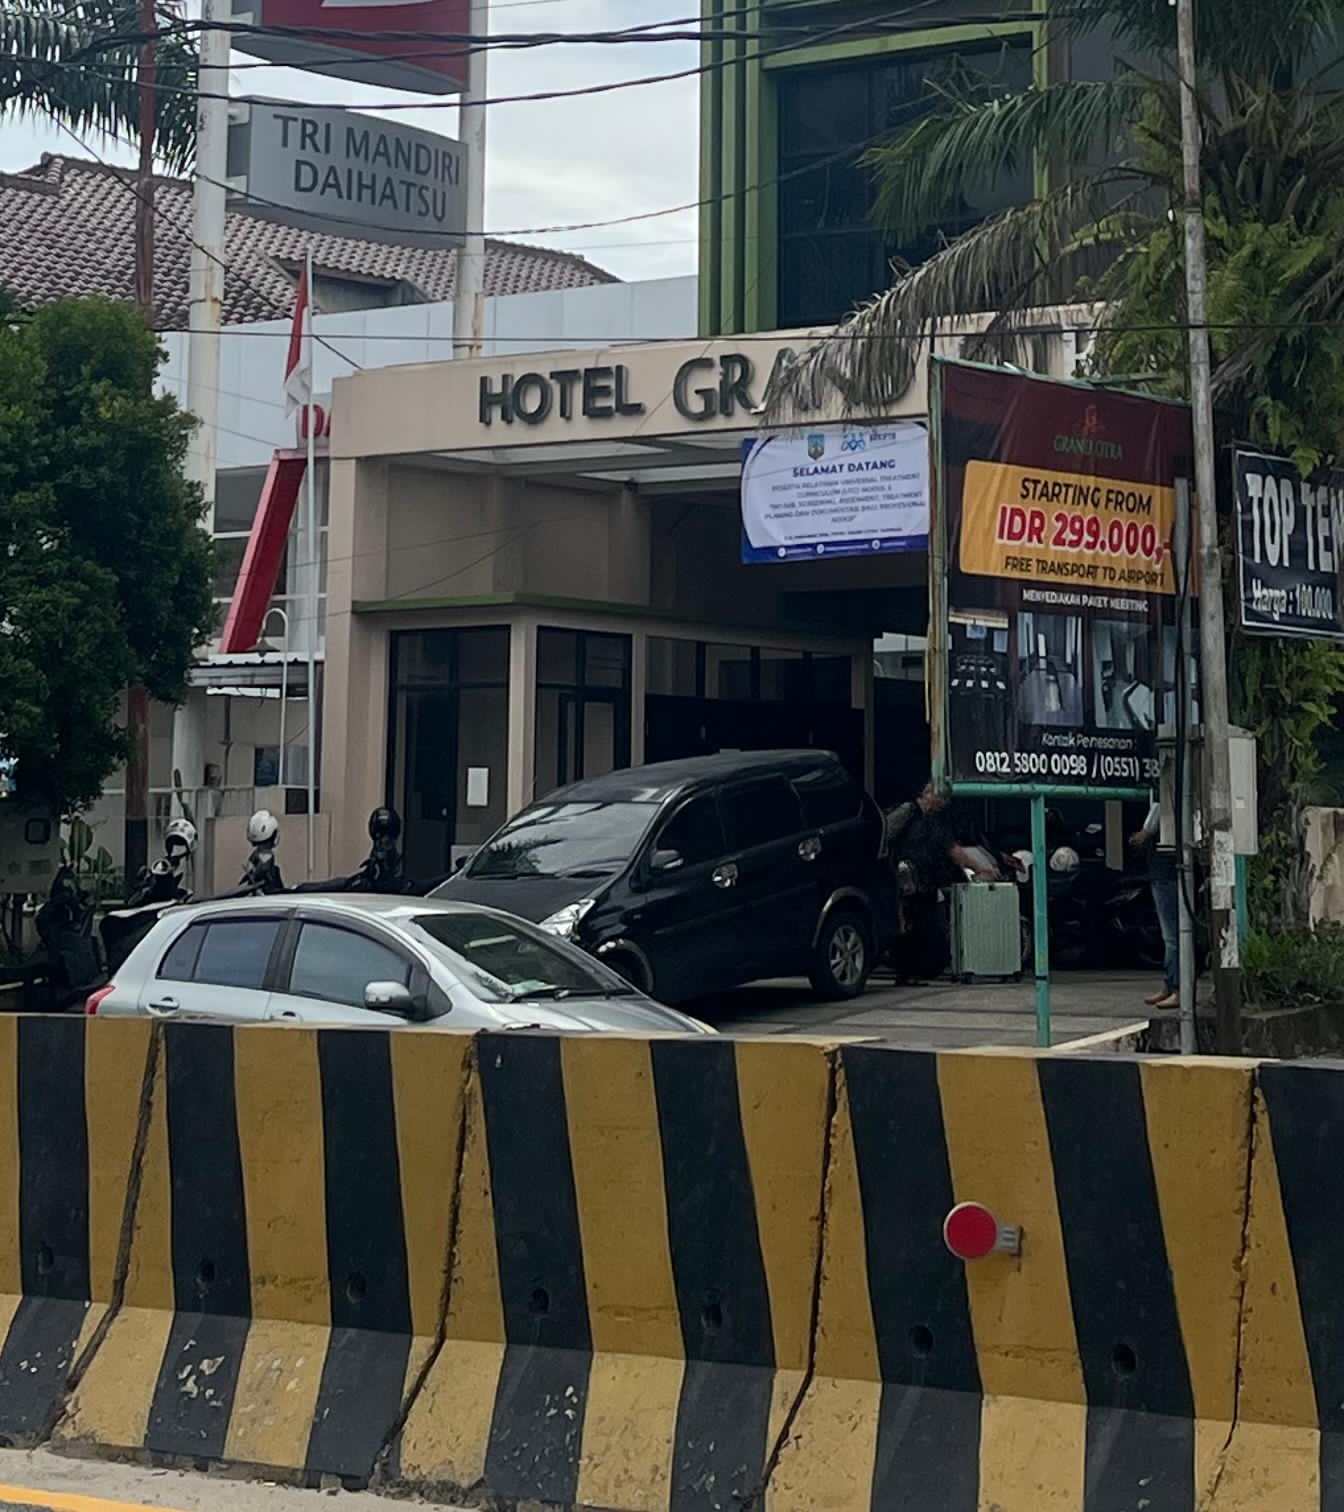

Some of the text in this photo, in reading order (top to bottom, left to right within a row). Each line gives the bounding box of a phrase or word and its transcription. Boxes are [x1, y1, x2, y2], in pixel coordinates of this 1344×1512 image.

[273, 114, 460, 186] TRI MANDIRI
[294, 160, 447, 223] DAIHATSU
[478, 364, 645, 426] HOTEL
[793, 459, 896, 478] SELAMAT DATANG
[1020, 477, 1153, 515] STARTING FROM
[997, 505, 1046, 545] IDR
[1245, 473, 1295, 568] TOP
[1005, 555, 1165, 587] FREE TRANSPORT TO AIRPORT
[1252, 578, 1287, 621] Harga
[975, 751, 1011, 774] 0812
[1013, 752, 1048, 775] 5800
[1051, 753, 1087, 776] 0098
[1091, 752, 1098, 778] /
[1101, 754, 1140, 781] (0551)
